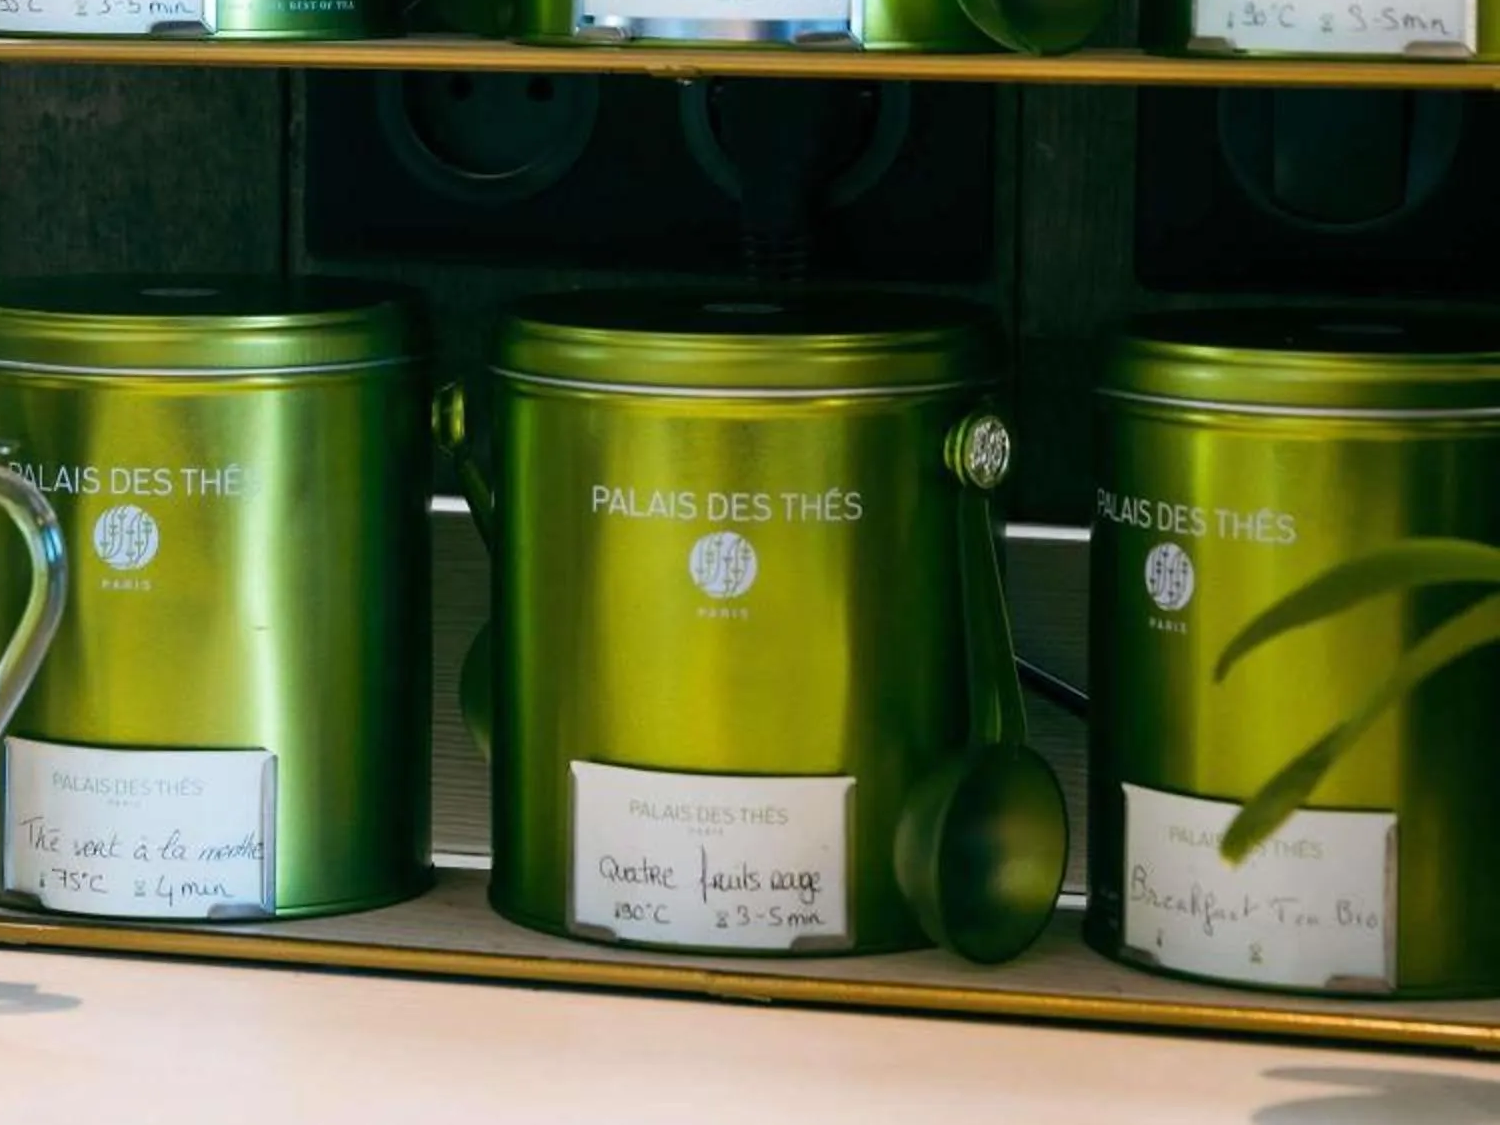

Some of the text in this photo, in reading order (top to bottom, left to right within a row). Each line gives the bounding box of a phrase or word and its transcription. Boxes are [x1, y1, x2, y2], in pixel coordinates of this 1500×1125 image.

[110, 467, 173, 496] DES
[592, 484, 863, 522] PALAIS DES THÉS
[1097, 487, 1298, 545] PALAIS DES THÉS
[52, 771, 111, 795] PALAIS
[629, 798, 693, 823] PALAIS
[696, 804, 735, 825] DES
[158, 828, 187, 862] la
